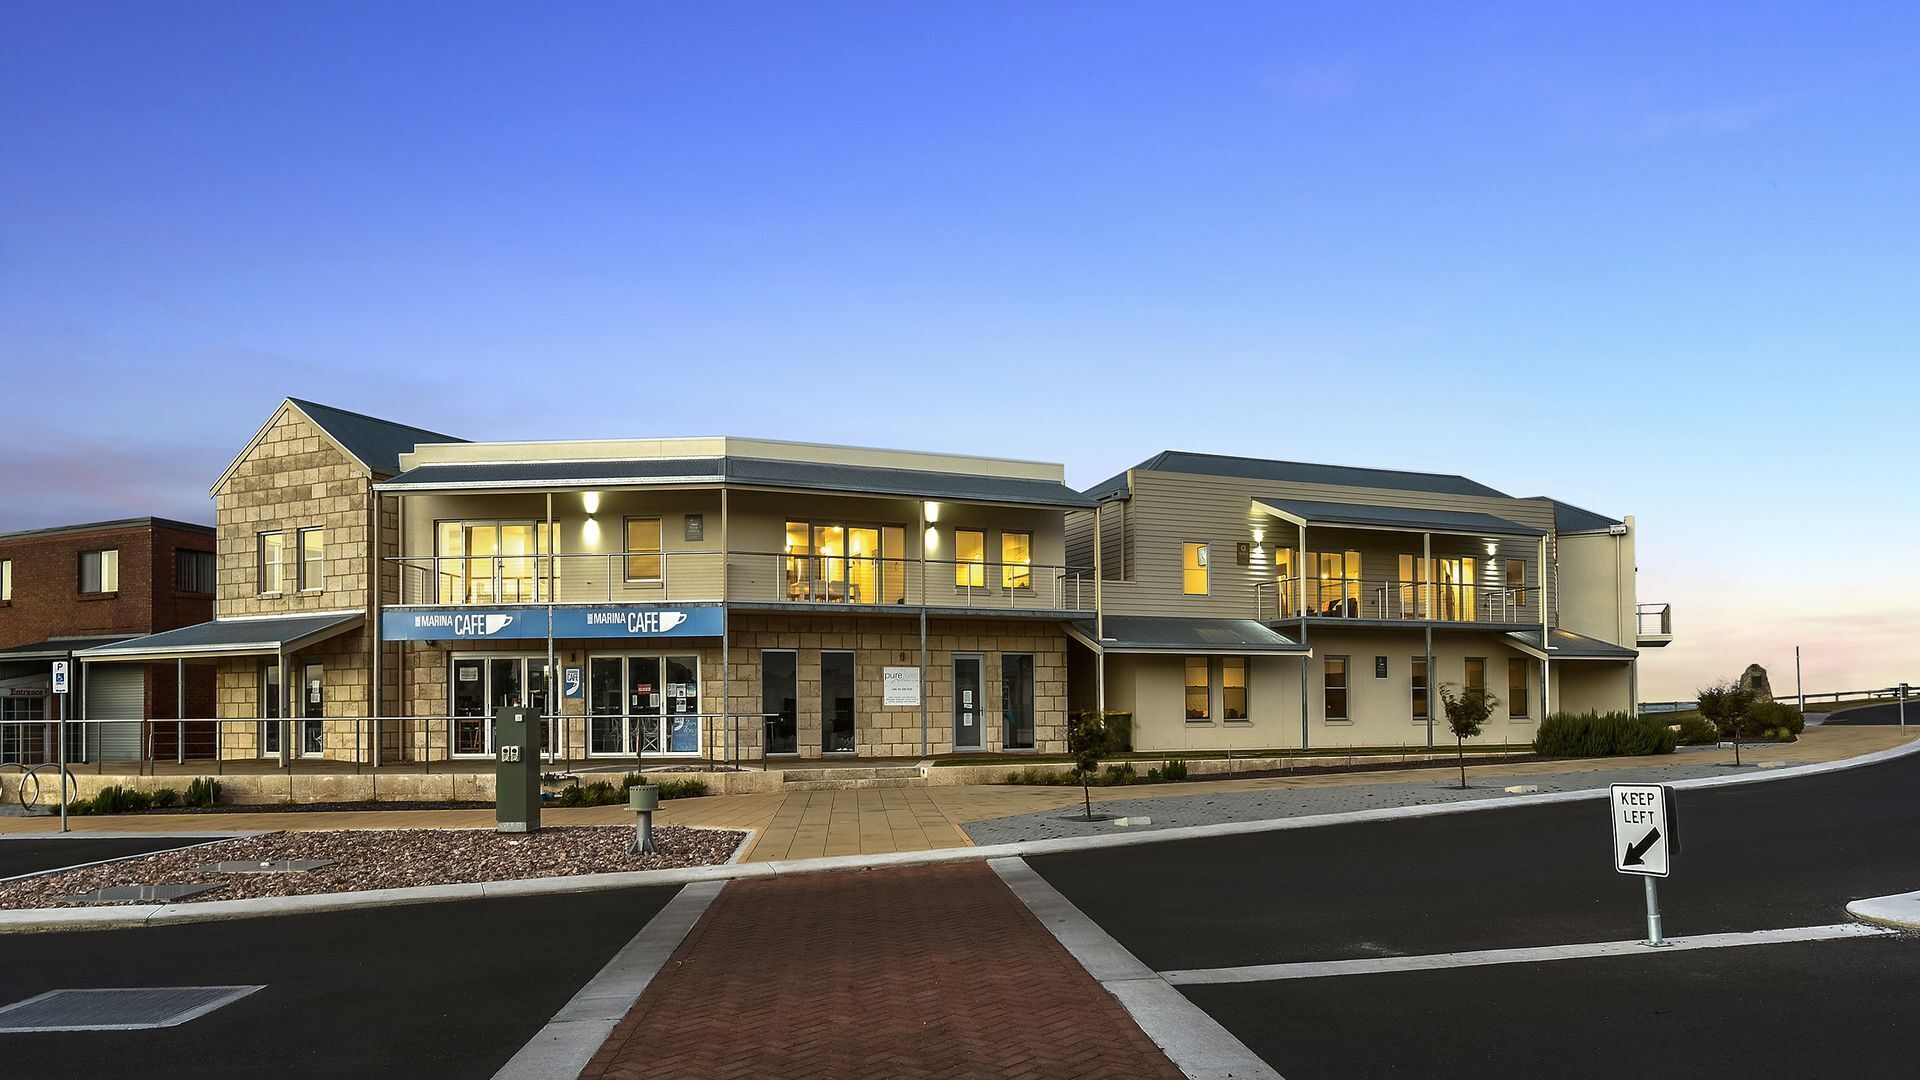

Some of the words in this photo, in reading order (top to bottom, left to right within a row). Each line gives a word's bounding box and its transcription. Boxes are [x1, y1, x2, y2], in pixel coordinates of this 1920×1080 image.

[421, 615, 453, 627] MARINA
[455, 614, 485, 636] CAFE
[593, 612, 626, 624] MARINA
[627, 612, 659, 633] CAFE
[57, 662, 63, 670] P
[10, 688, 43, 696] Entrance
[1621, 792, 1654, 805] KEEP
[1624, 810, 1654, 824] LEFT
